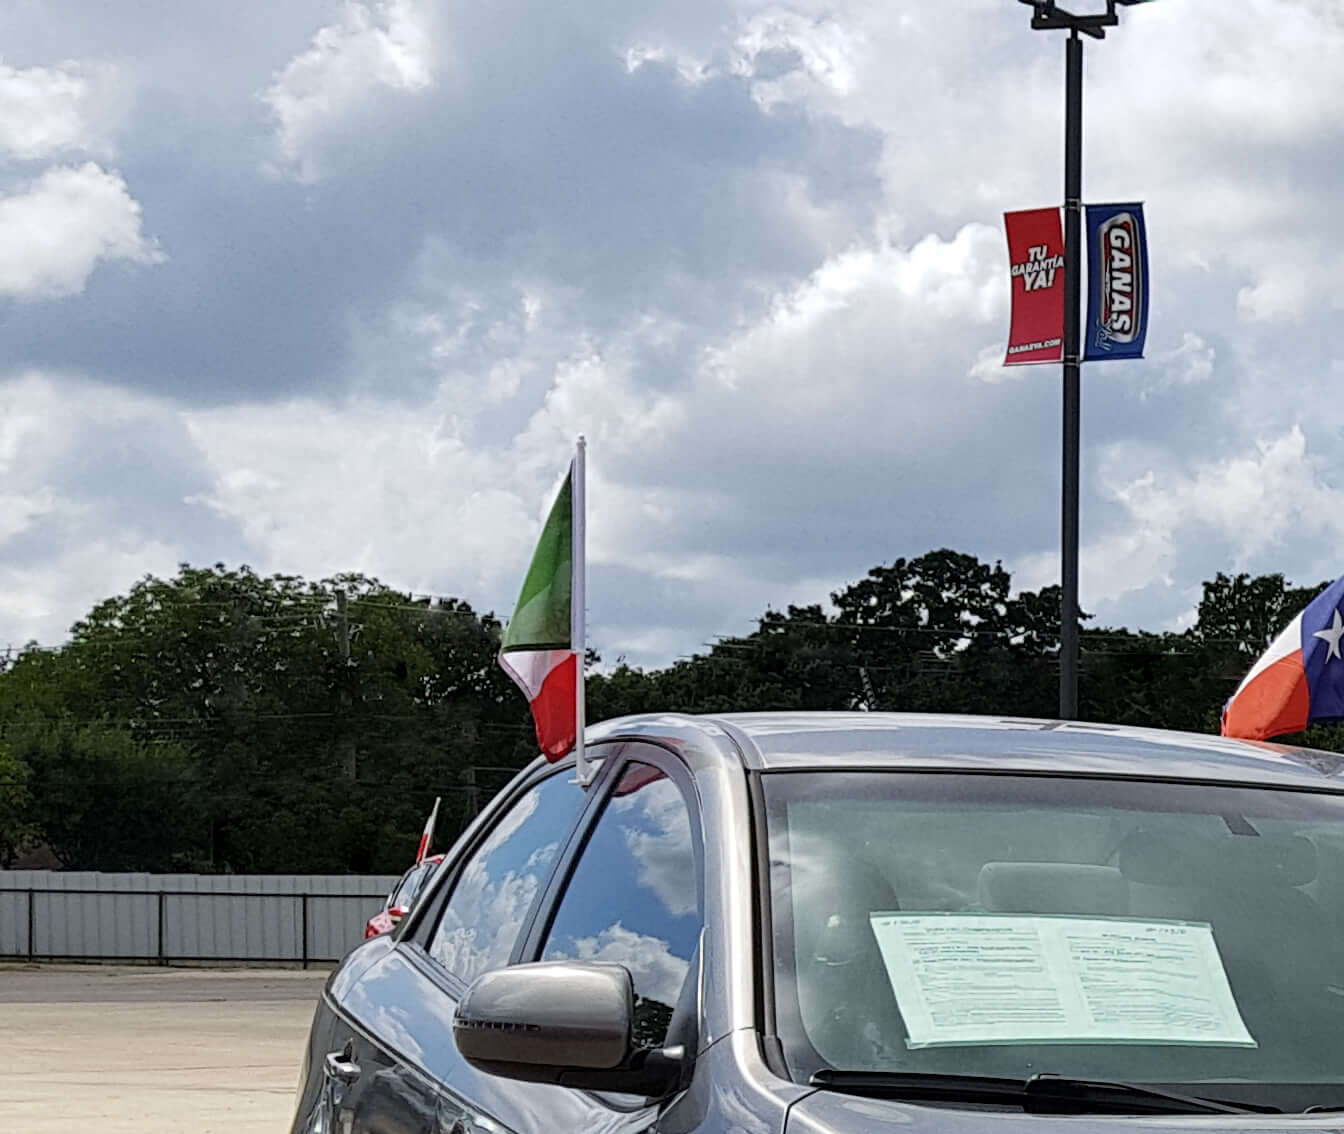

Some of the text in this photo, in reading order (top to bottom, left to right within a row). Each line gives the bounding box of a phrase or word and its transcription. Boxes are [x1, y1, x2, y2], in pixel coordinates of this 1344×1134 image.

[1028, 245, 1048, 262] TU
[1011, 254, 1064, 277] GARANTÍA
[1023, 269, 1055, 291] YA!
[1109, 227, 1133, 336] GANAS
